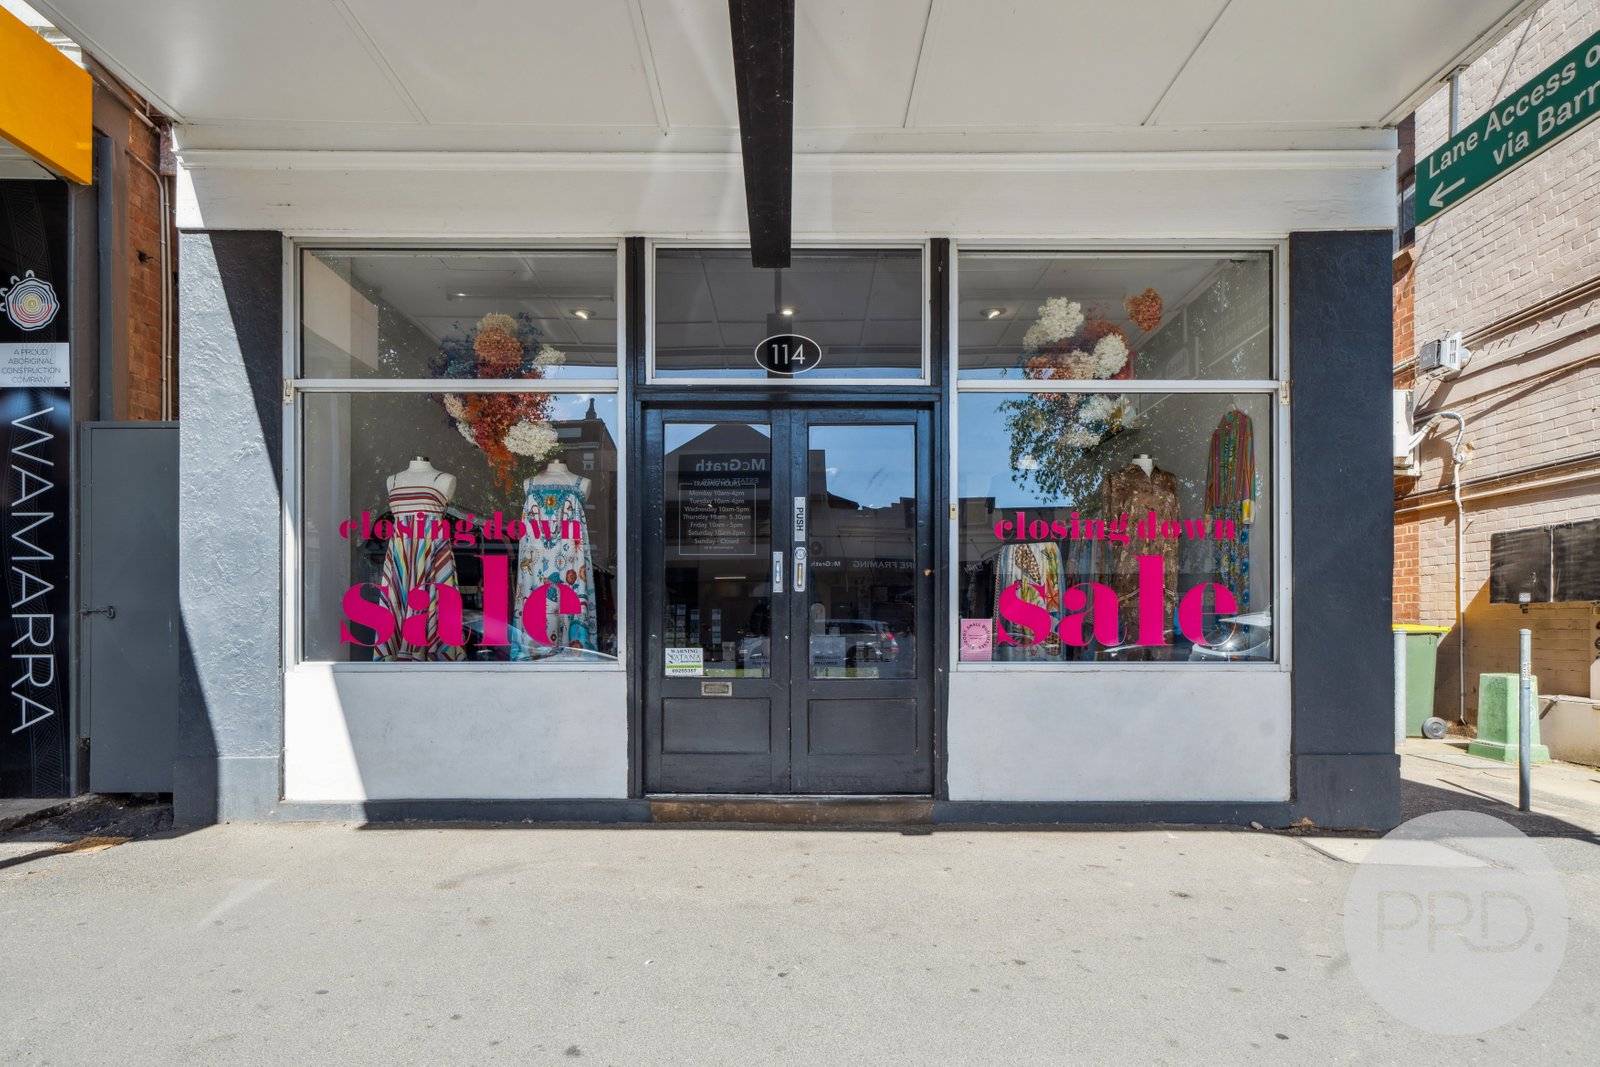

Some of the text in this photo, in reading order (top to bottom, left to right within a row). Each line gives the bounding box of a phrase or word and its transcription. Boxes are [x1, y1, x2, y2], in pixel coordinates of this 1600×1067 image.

[1429, 131, 1478, 180] Lane
[1483, 61, 1576, 141] Access
[1492, 80, 1600, 165] via Barr
[772, 344, 806, 365] 114
[339, 511, 582, 547] closing down
[796, 507, 804, 531] PUSH
[994, 511, 1236, 547] closing down
[11, 406, 54, 734] WAMARRA
[340, 554, 582, 647] sale
[997, 554, 1238, 647] sale
